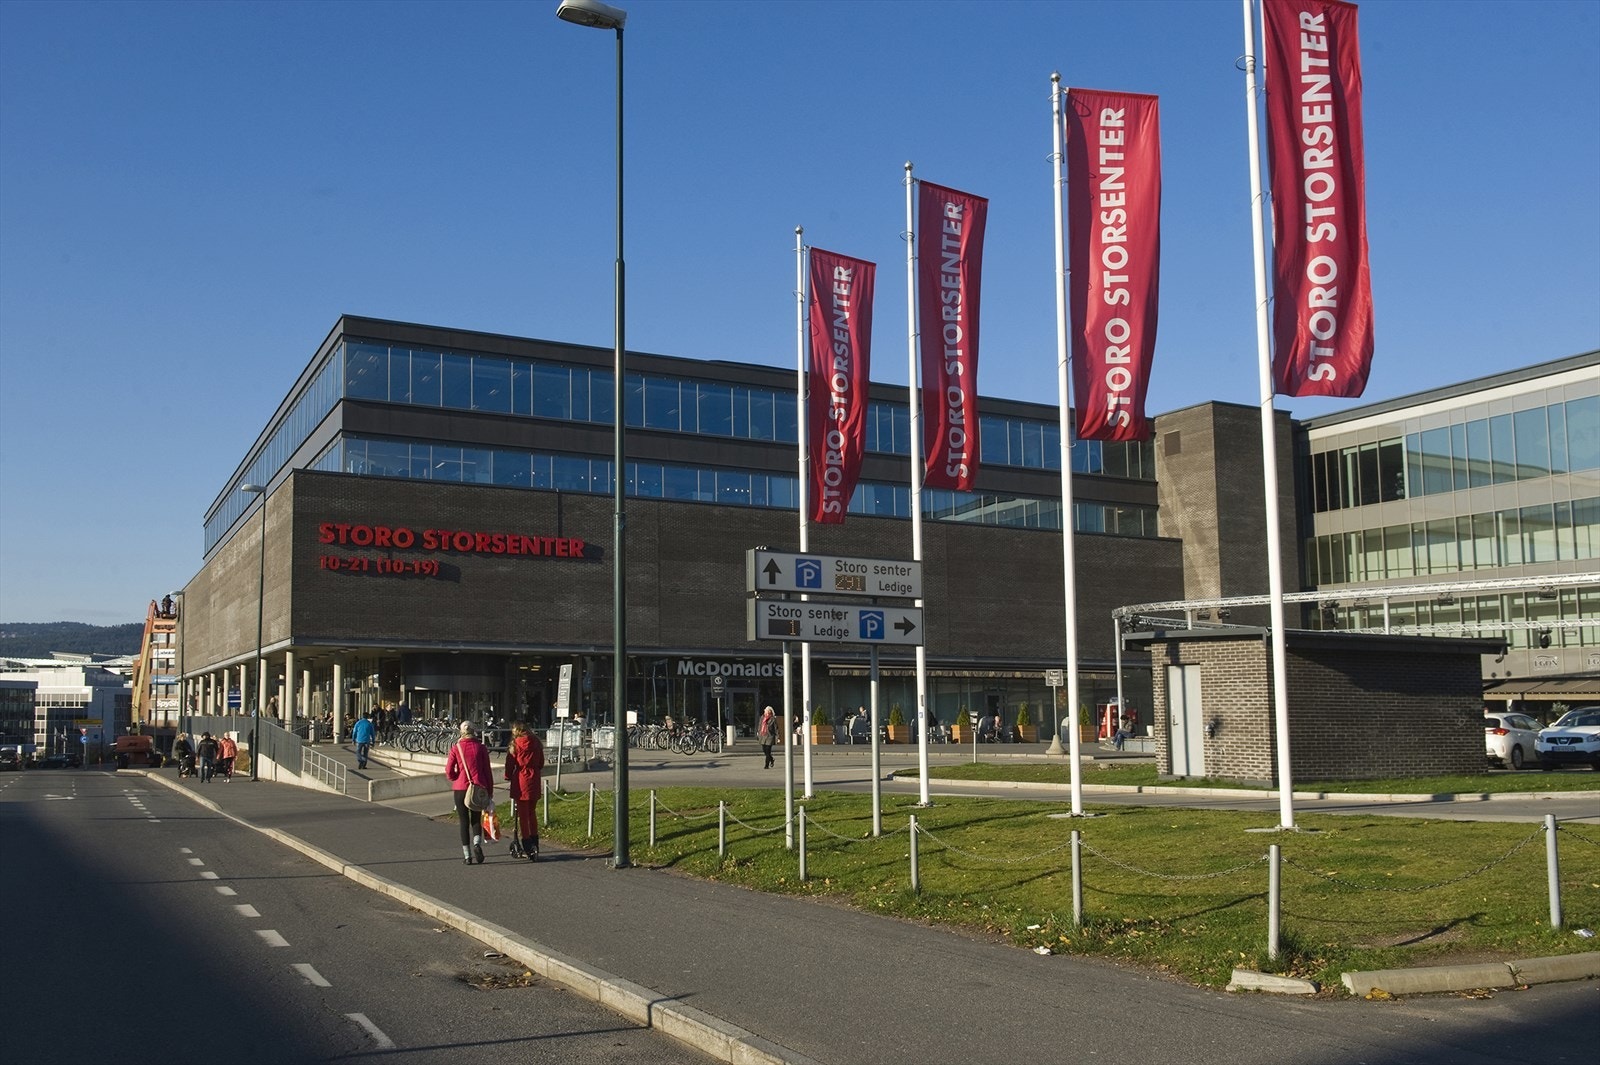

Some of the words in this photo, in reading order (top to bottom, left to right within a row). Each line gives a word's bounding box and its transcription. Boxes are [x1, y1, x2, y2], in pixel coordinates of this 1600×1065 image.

[1299, 11, 1337, 243] STORSENTER
[1100, 107, 1130, 307] STORSENTER
[941, 201, 964, 376] STORSENTER
[1306, 254, 1338, 382] STORO
[828, 264, 852, 422] STORSENTER
[1105, 316, 1133, 429] STORO
[822, 430, 845, 514] STORO
[946, 385, 968, 479] STORO
[318, 522, 415, 548] STORO
[422, 529, 585, 558] STORSENTER
[319, 555, 369, 571] 10-21
[376, 556, 439, 576] (10-19)
[835, 559, 868, 574] Storo
[873, 564, 912, 576] senter
[768, 604, 802, 618] Storo
[808, 608, 849, 620] senter
[878, 580, 913, 595] Ledige
[677, 660, 784, 677] McDonald's
[814, 624, 849, 640] Ledige
